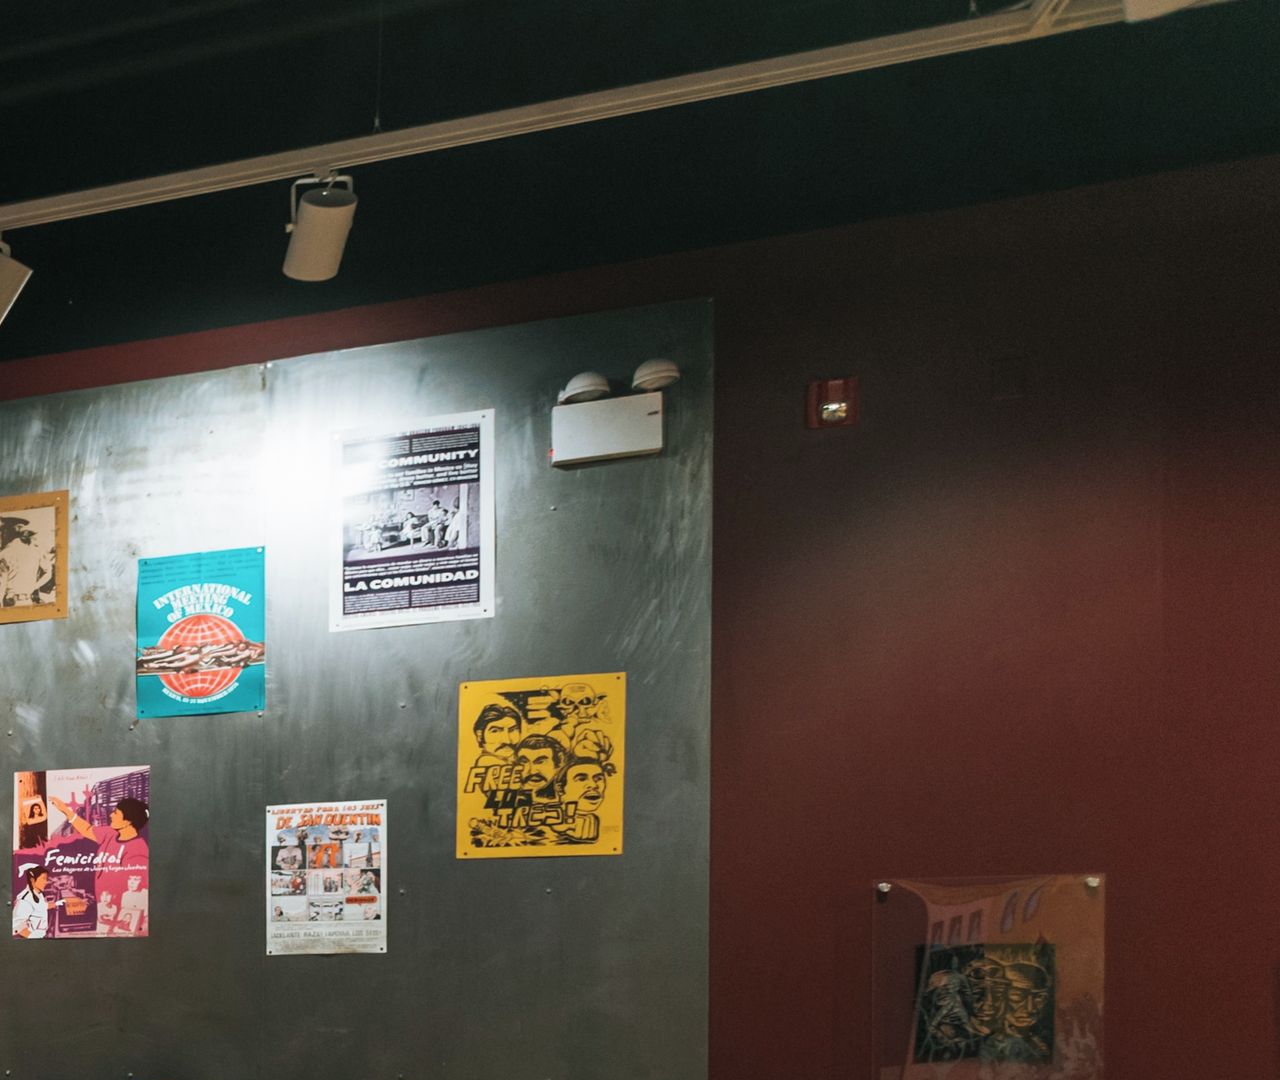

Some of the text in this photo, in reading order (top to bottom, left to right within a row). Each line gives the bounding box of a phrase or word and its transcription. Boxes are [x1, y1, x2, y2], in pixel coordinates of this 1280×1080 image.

[378, 449, 478, 468] COMMUNITY
[344, 569, 479, 593] LA COMUNIDAD
[153, 583, 252, 610] INTERNATIONAL
[173, 591, 228, 609] MEETING
[167, 603, 233, 622] OF MEXICO
[464, 764, 524, 793] FREE
[484, 789, 533, 809] LOS
[271, 807, 313, 815] LIBERTAD
[316, 805, 338, 813] PARA
[497, 801, 578, 829] TRES!
[276, 813, 382, 830] DE SAN QUENTIN
[44, 845, 125, 866] Femicidio!
